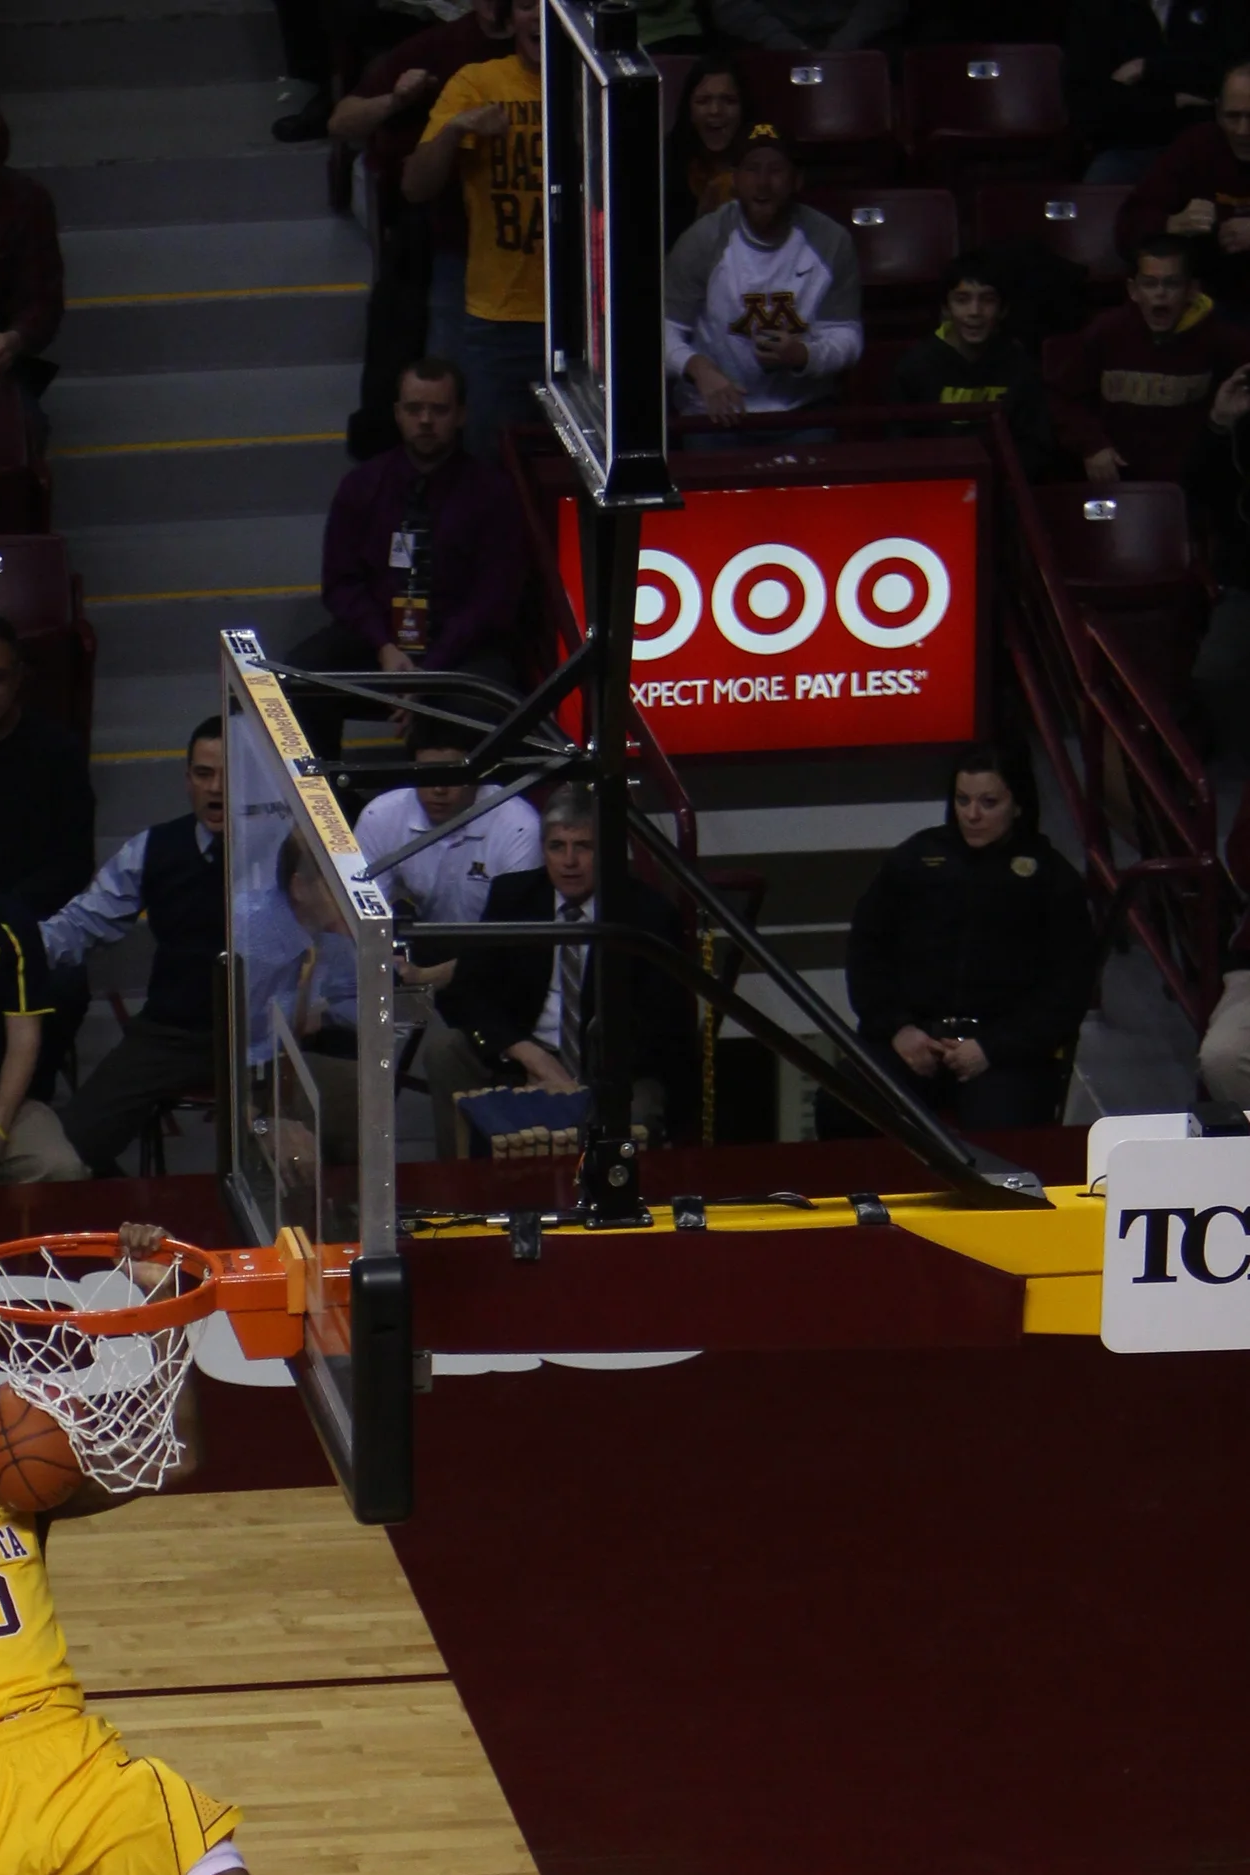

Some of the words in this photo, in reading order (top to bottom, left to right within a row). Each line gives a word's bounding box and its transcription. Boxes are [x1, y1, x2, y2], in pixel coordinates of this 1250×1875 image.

[630, 679, 710, 708] XPECT
[712, 675, 789, 705] MORE.
[795, 672, 848, 700] PAY
[1119, 1205, 1250, 1285] TC
